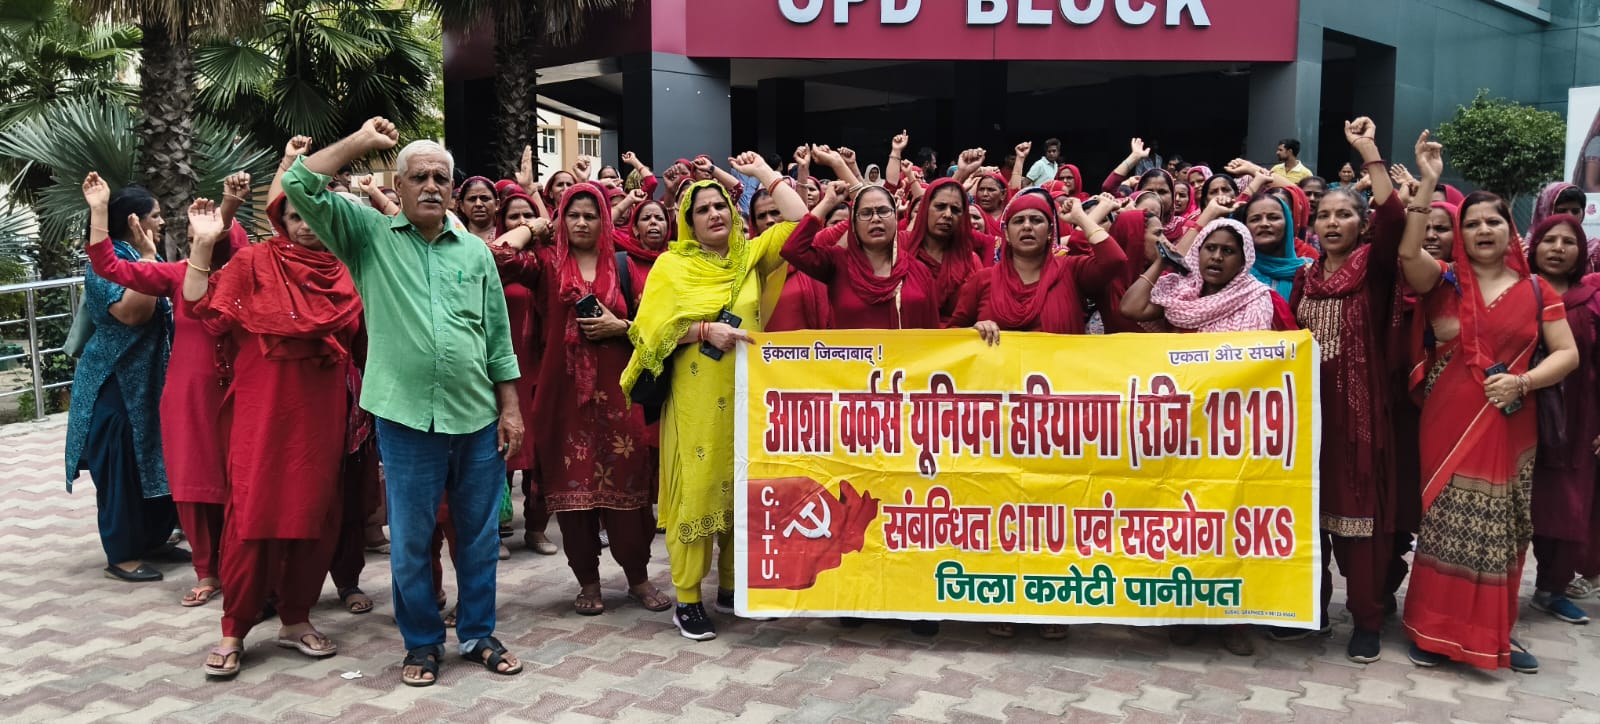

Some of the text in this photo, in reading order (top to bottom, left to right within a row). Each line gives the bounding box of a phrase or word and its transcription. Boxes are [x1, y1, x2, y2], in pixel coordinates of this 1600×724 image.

[761, 341, 810, 362] इंकलाब
[814, 341, 875, 365] जिन्दाबाद्
[1169, 350, 1209, 364] एकता
[1215, 344, 1243, 360] और
[1248, 340, 1285, 359] संघर्ष
[765, 370, 1294, 476] आशा वर्कर्स यूनियन हरियाणा (रजि. 1919)
[882, 487, 1293, 560] संबन्धित CITU एवं सहयोग SKS
[935, 561, 1242, 606] जिला कमेटी पानीपत
